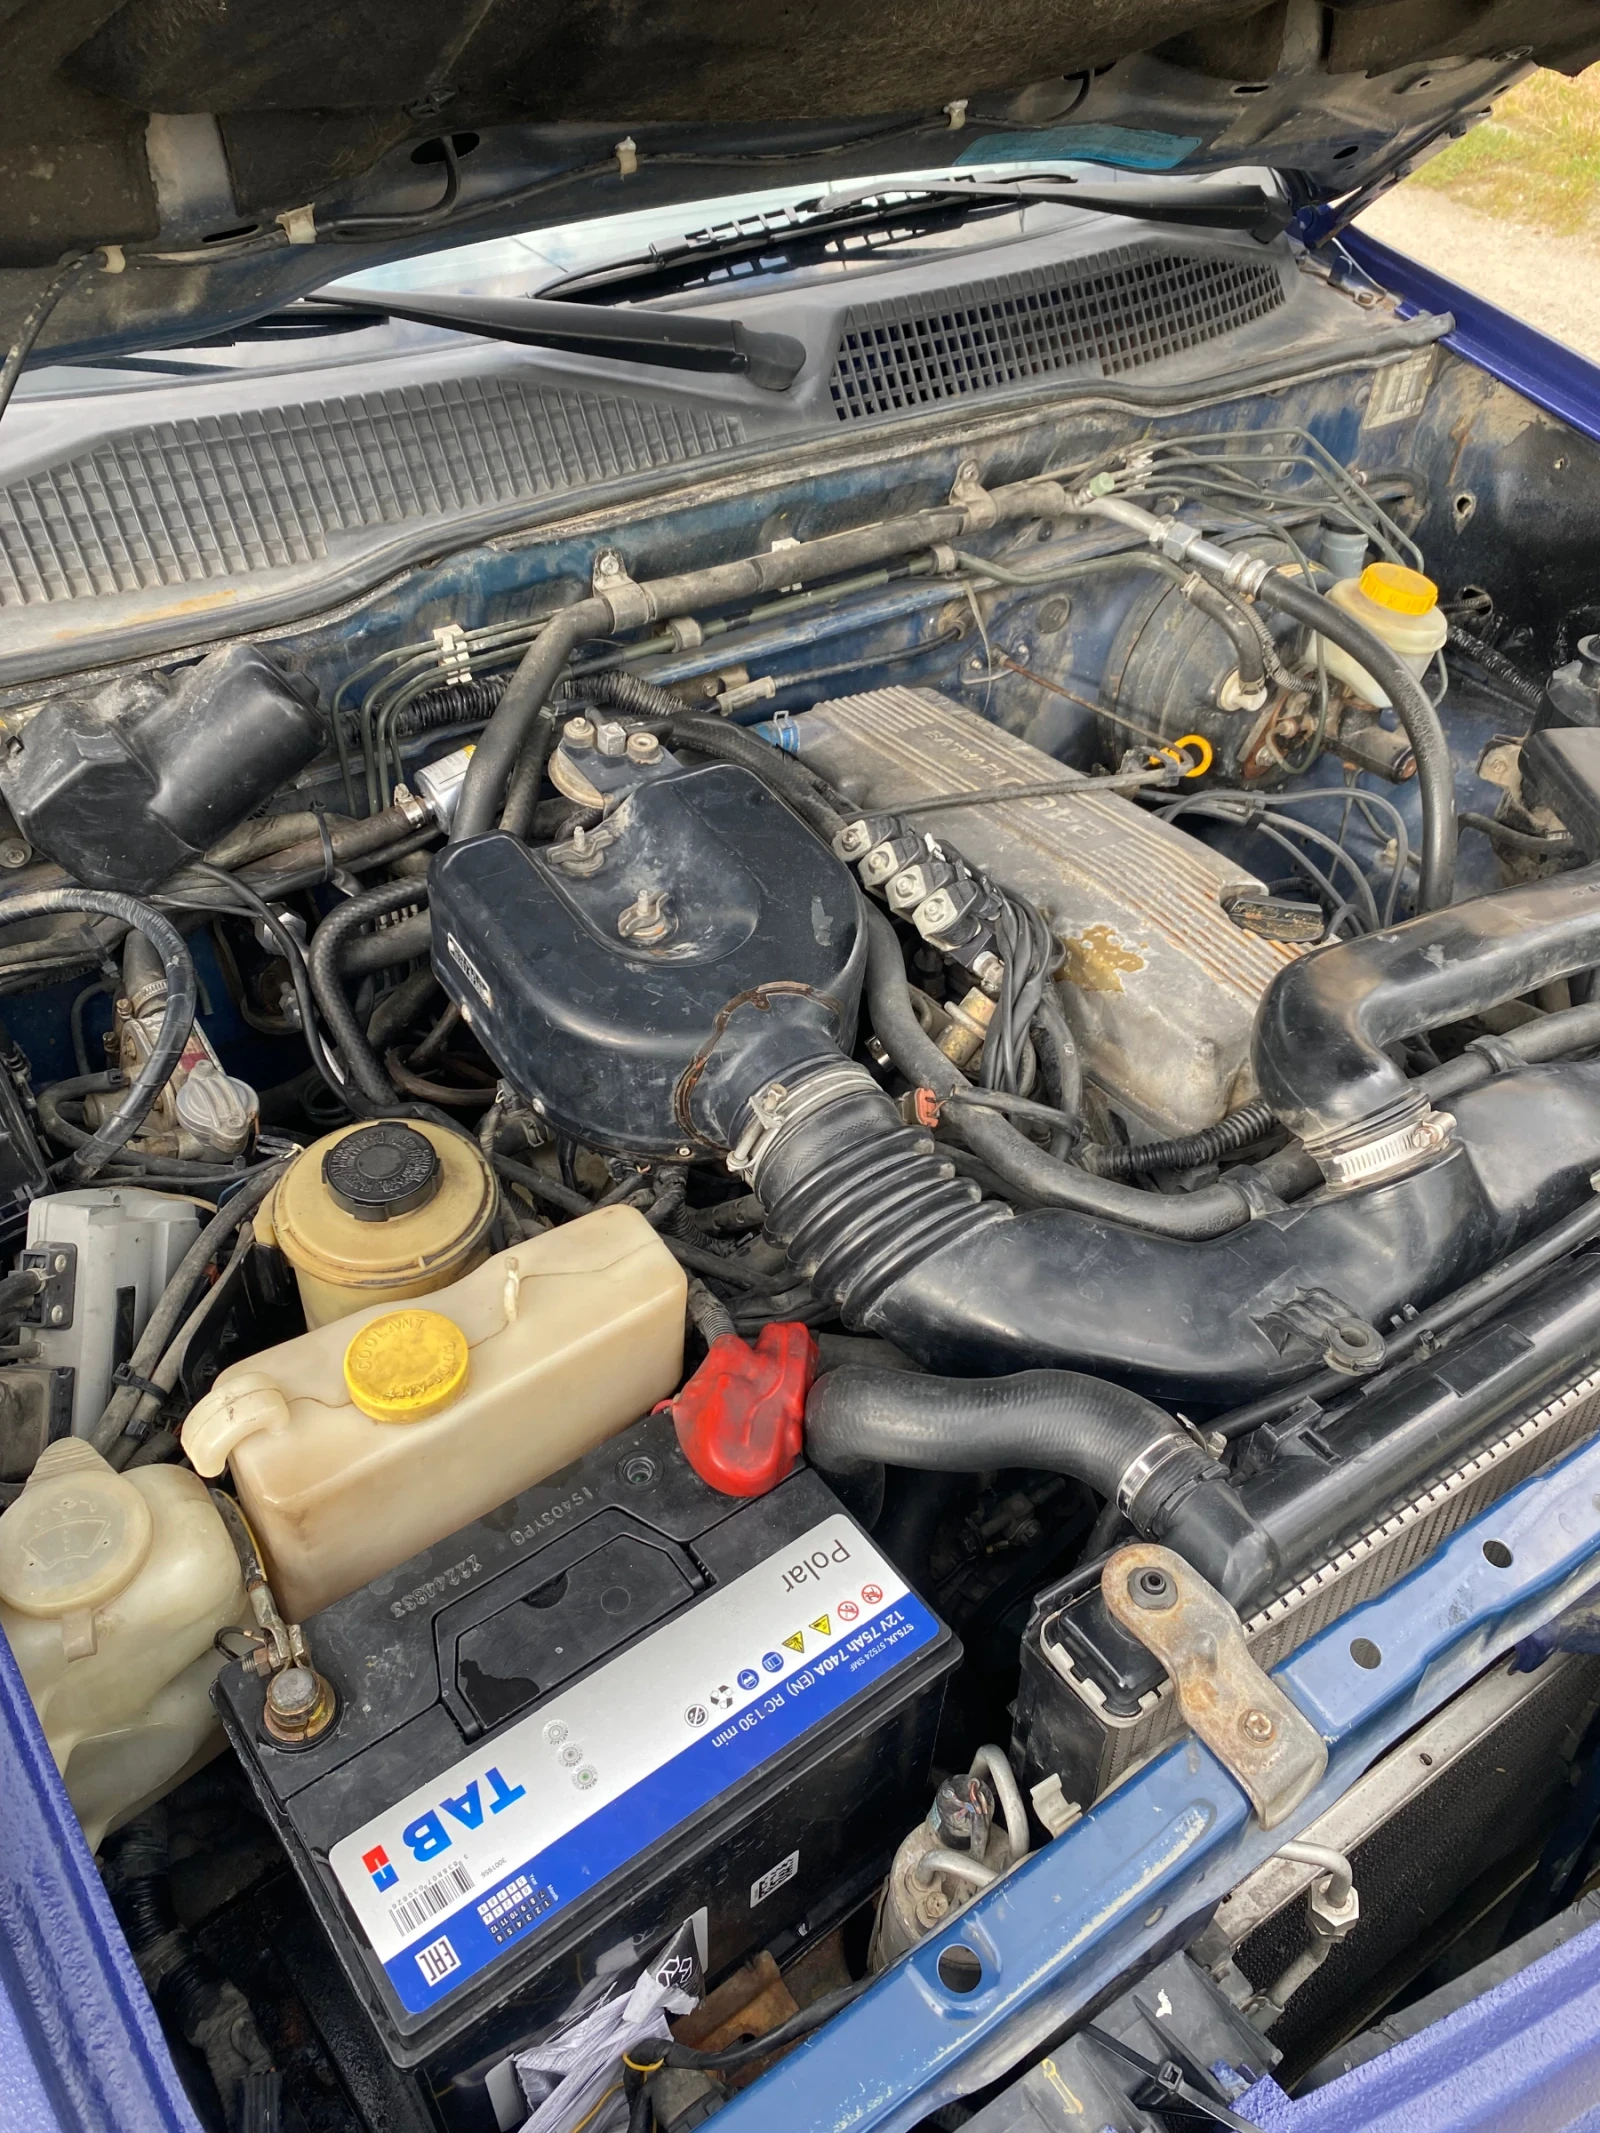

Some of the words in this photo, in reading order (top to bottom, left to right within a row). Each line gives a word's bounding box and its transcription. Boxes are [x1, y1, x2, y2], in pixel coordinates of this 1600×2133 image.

[357, 1316, 427, 1372] COOLANT
[781, 1539, 851, 1593] Polar
[880, 1610, 905, 1632] 12V
[848, 1625, 881, 1653] 75Ah
[866, 1643, 886, 1661] 57524
[813, 1649, 850, 1677] 740A
[850, 1655, 867, 1672] SMF
[786, 1671, 815, 1697] (EN)
[764, 1693, 785, 1713] RC
[738, 1709, 765, 1731] 130
[711, 1728, 739, 1748] min
[403, 1767, 526, 1862] TAB
[419, 1940, 457, 1982] EAC
